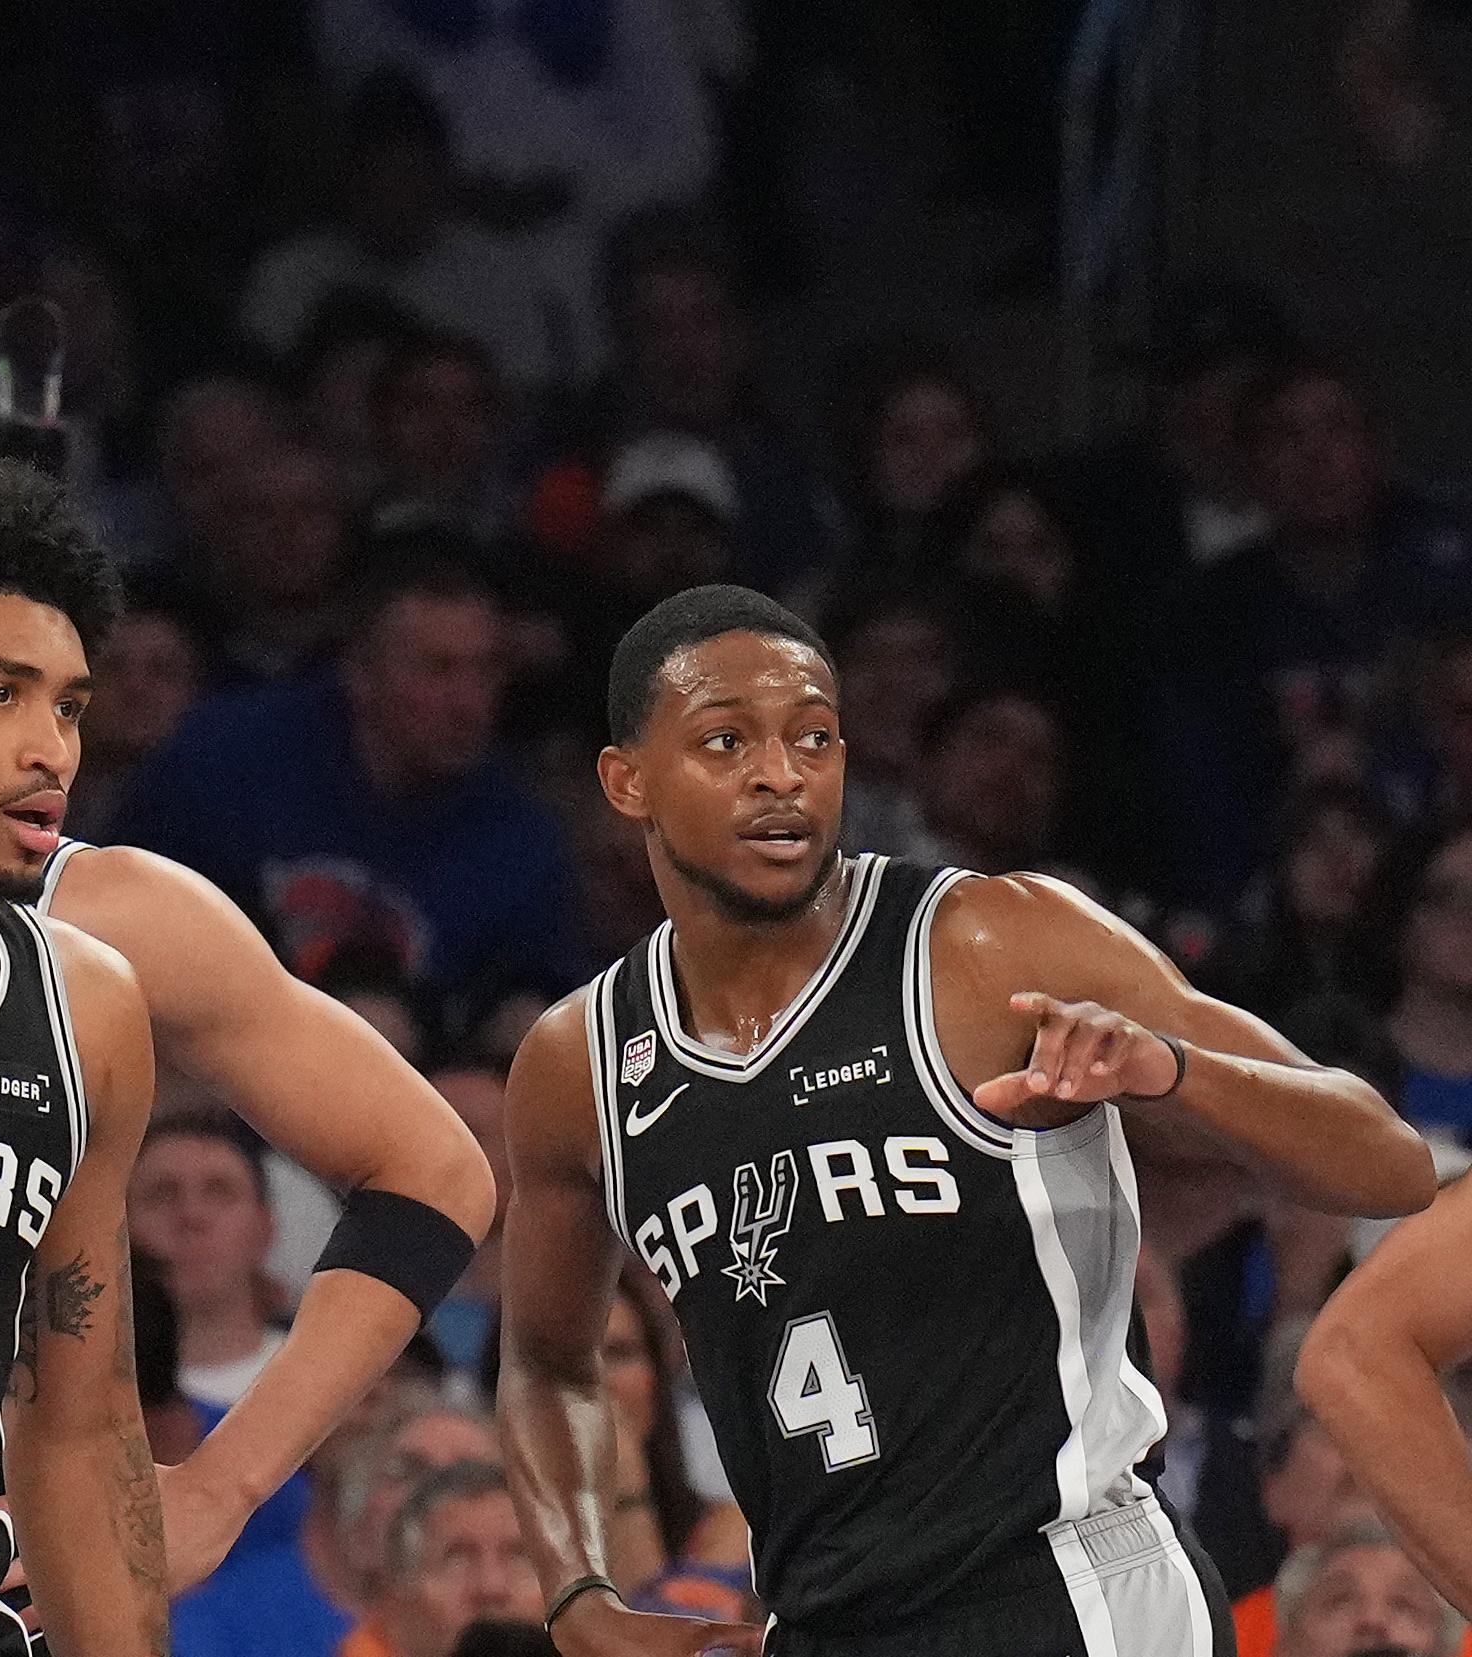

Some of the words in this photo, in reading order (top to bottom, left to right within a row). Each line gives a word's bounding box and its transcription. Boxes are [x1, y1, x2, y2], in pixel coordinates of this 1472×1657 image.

[628, 1038, 651, 1058] USA
[624, 1056, 651, 1078] 250
[803, 1059, 877, 1092] LEDGER
[634, 1136, 961, 1307] SPURS
[766, 1309, 881, 1474] 4
